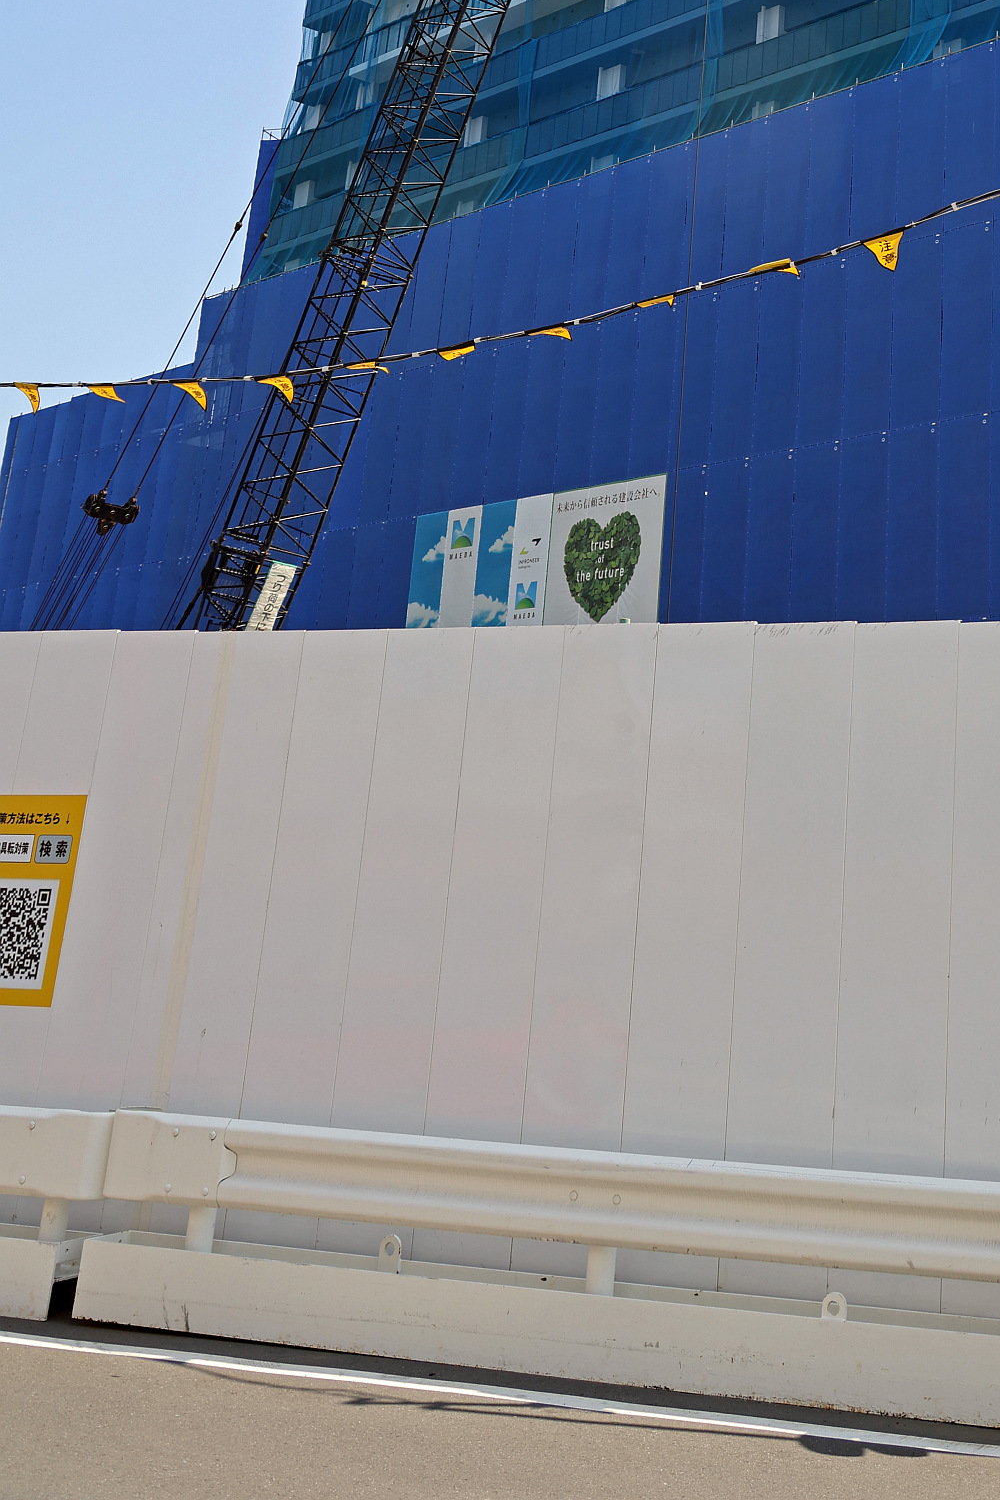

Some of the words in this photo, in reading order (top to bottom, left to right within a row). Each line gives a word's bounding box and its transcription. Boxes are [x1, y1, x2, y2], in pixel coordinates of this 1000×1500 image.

[879, 240, 897, 266] 注意
[591, 537, 614, 552] trust
[449, 551, 473, 561] MAEDA
[597, 554, 605, 564] of
[577, 569, 591, 583] the
[594, 567, 624, 580] future
[513, 611, 536, 621] MAEDA
